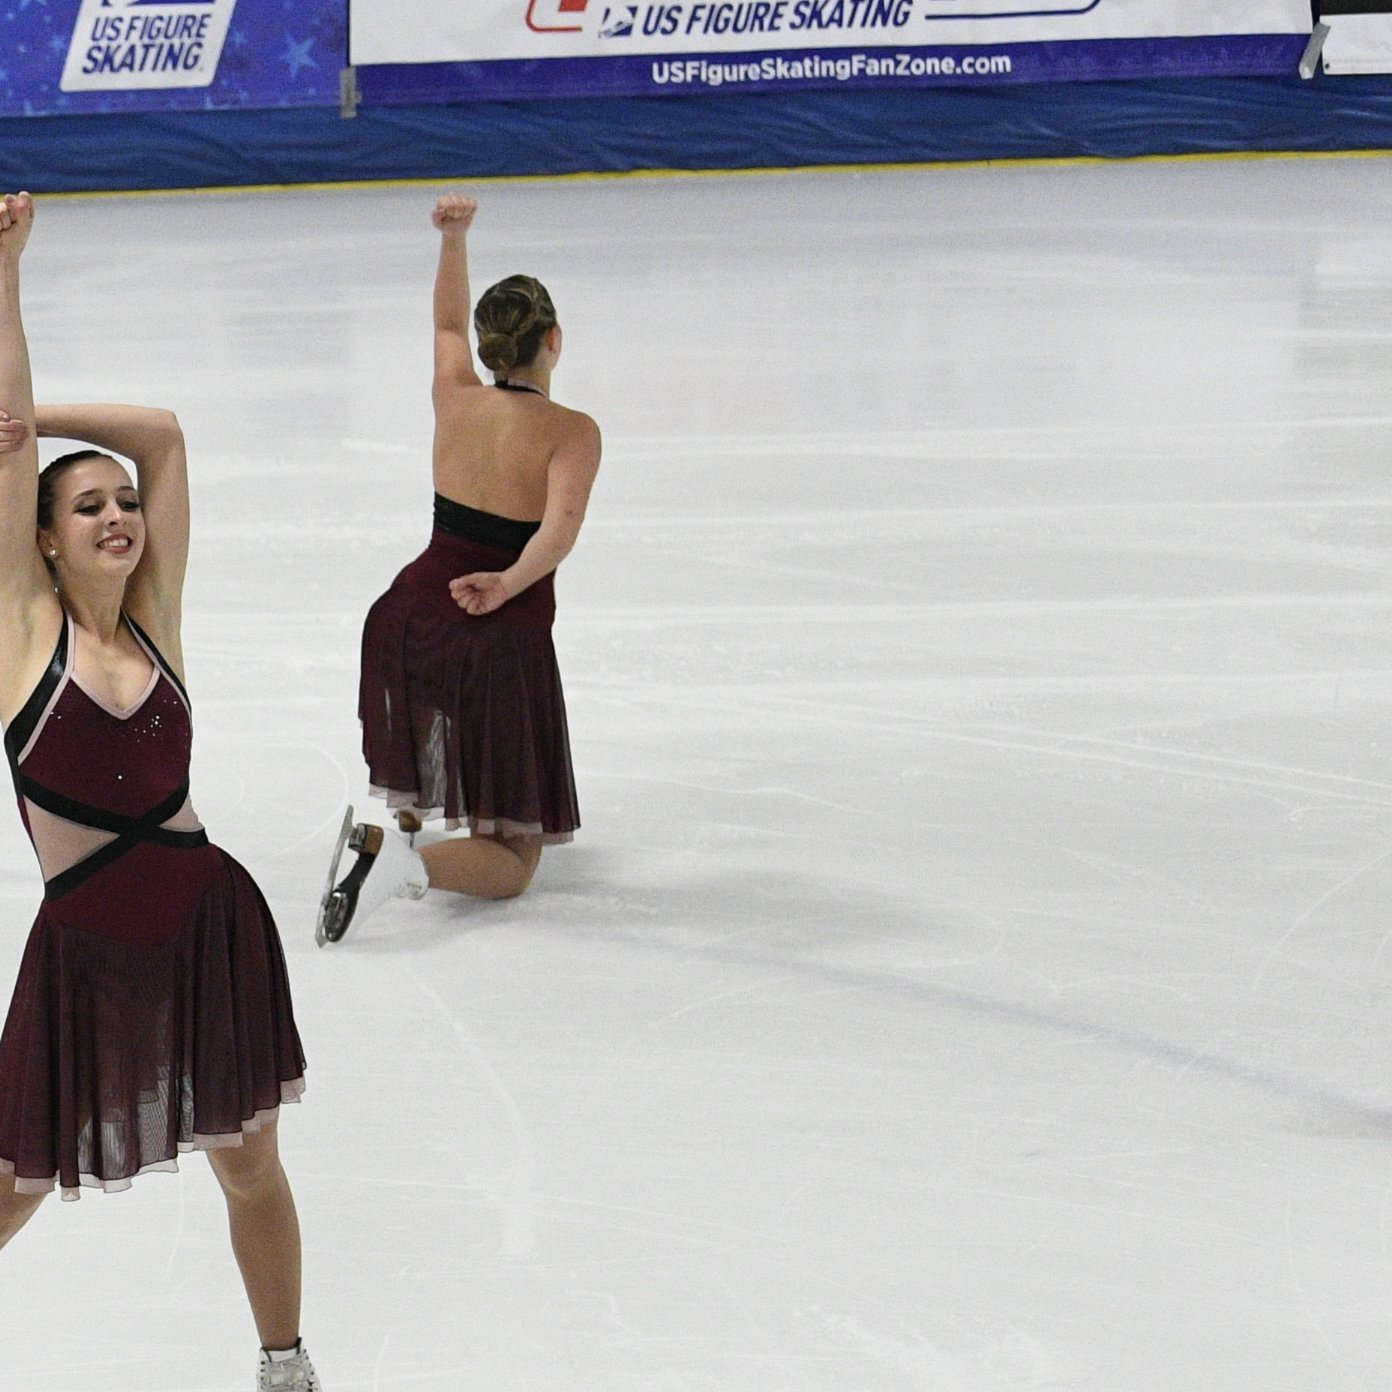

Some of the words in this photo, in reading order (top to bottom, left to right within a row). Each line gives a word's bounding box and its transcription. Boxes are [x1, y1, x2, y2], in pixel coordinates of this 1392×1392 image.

[91, 16, 122, 41] US
[124, 14, 211, 41] FIGURE
[642, 4, 681, 35] US
[685, 1, 790, 34] FIGURE
[790, 0, 911, 30] SKATING
[82, 42, 203, 74] SKATING
[652, 54, 1012, 85] USFigureSkatingFanZone.com
